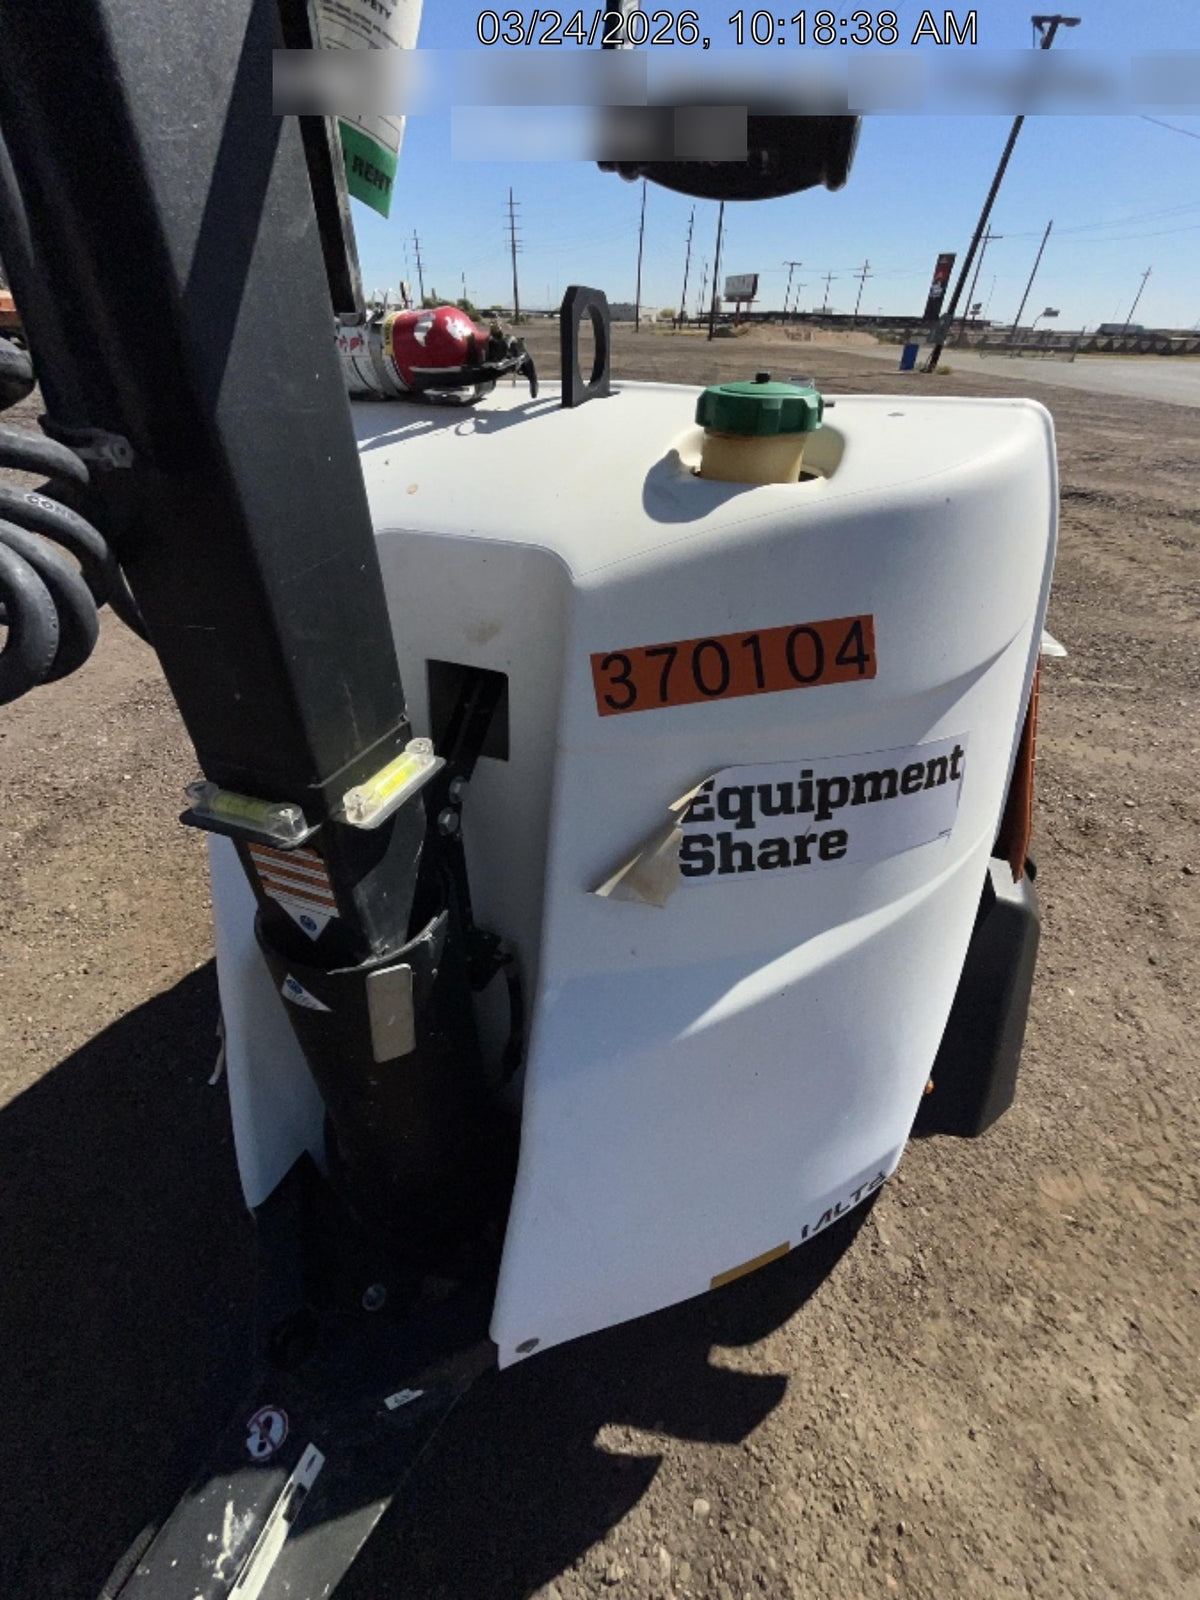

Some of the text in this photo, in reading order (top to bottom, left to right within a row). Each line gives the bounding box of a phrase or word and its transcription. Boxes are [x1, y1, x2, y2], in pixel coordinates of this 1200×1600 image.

[599, 619, 872, 711] 370104
[681, 743, 964, 829] Equipment
[678, 828, 849, 878] Share
